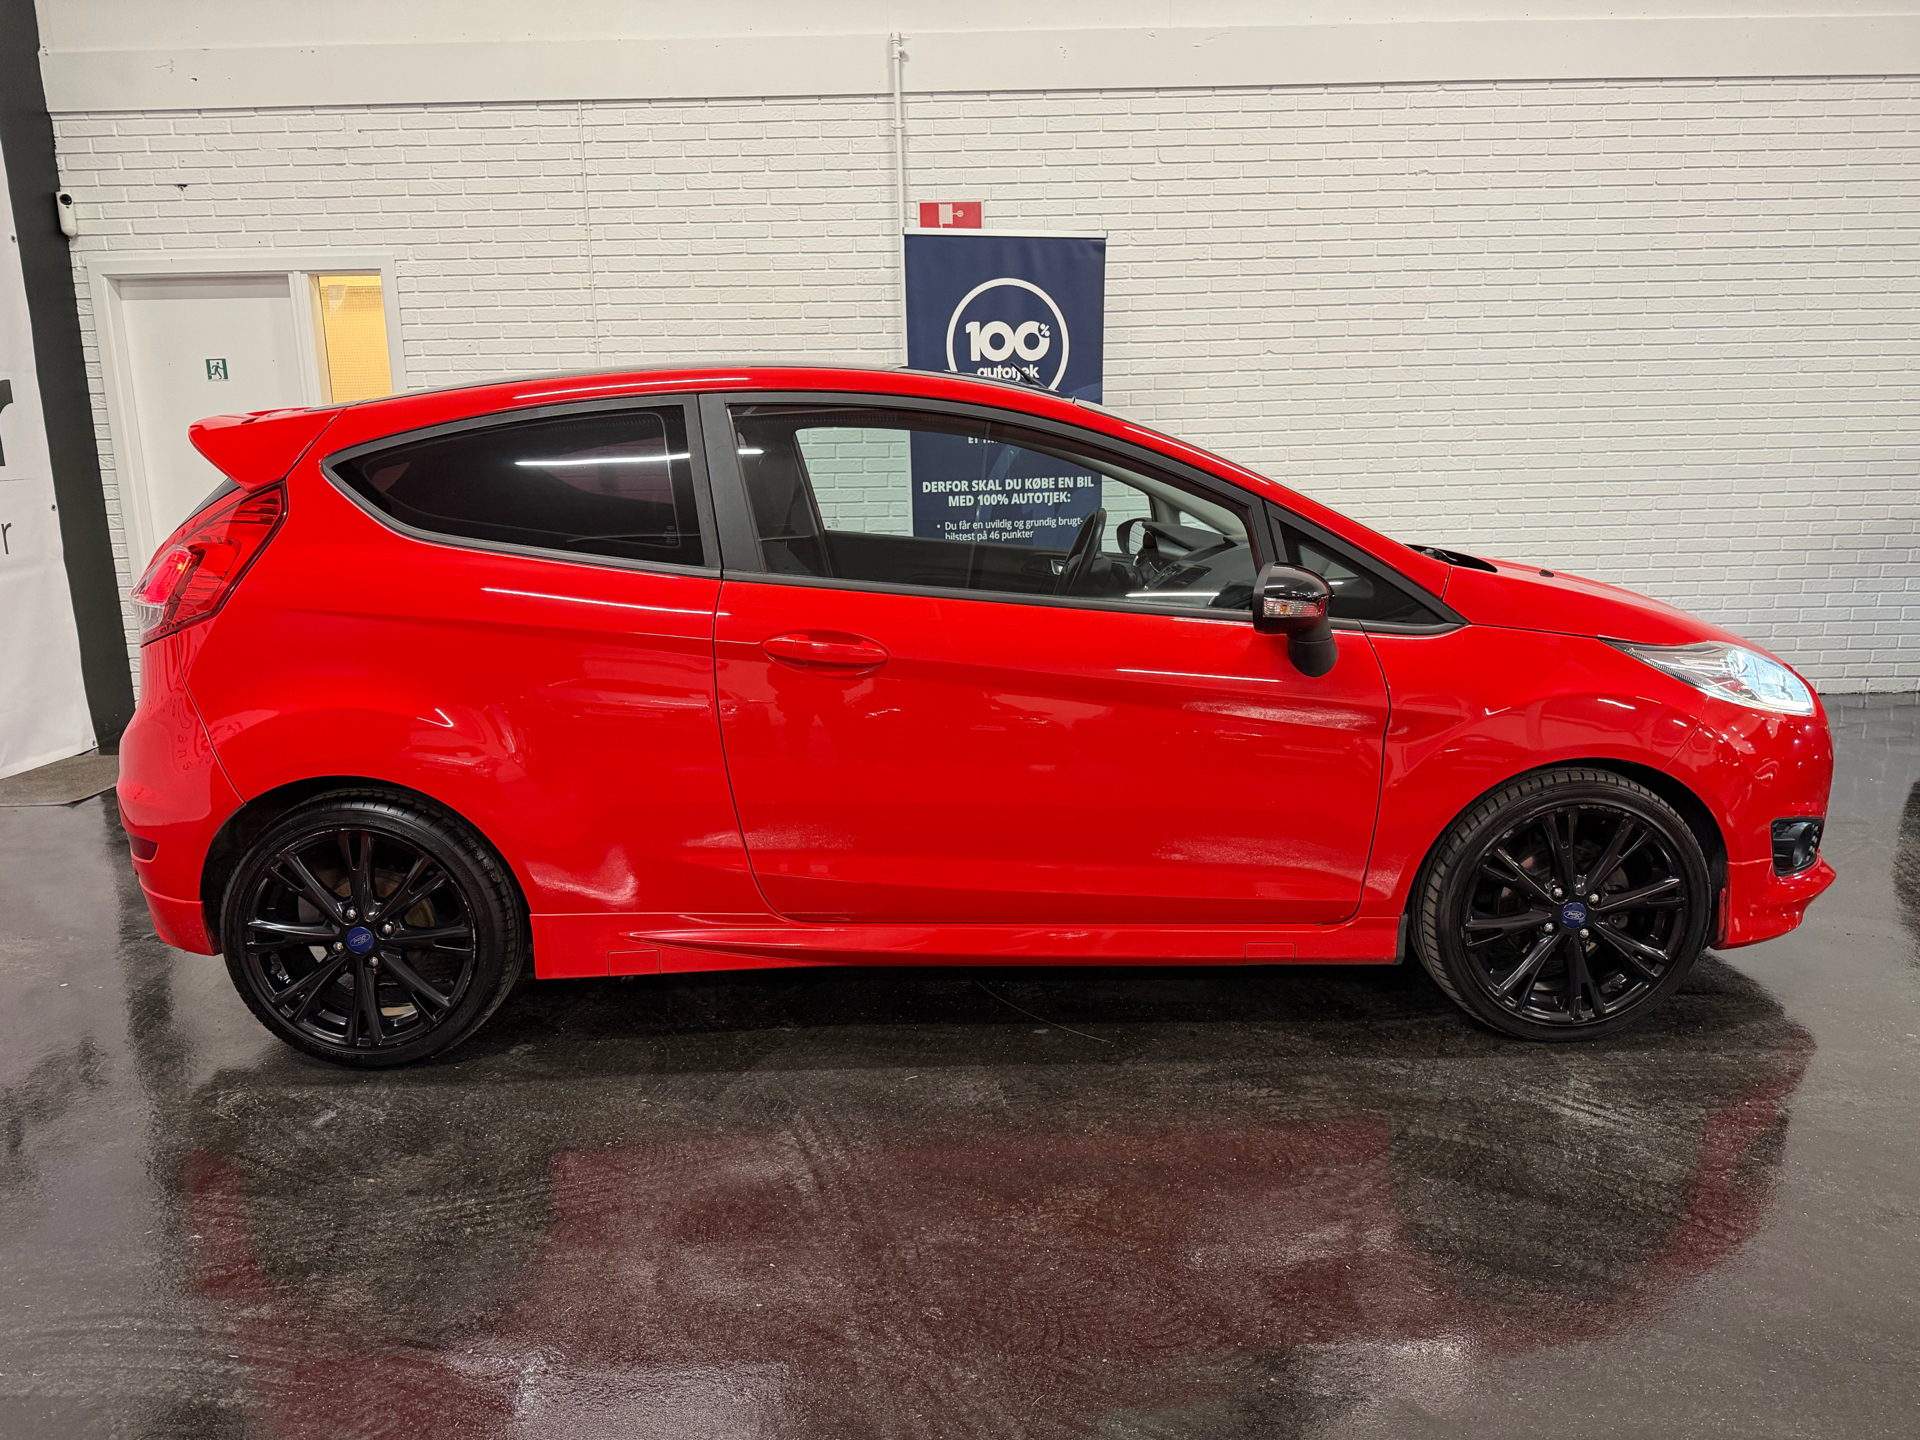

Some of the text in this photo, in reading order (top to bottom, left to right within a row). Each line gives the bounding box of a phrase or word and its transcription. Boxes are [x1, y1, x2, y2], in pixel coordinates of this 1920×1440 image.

[922, 475, 1094, 493] DERFOR SKAL DU KØBE EN BIL
[948, 491, 1071, 507] MED 100% AUTOTJEK:
[944, 516, 1083, 531] Du får en uvildig og grundig brugt-
[977, 530, 988, 542] på
[989, 530, 1000, 540] 46
[1001, 530, 1034, 542] punkter
